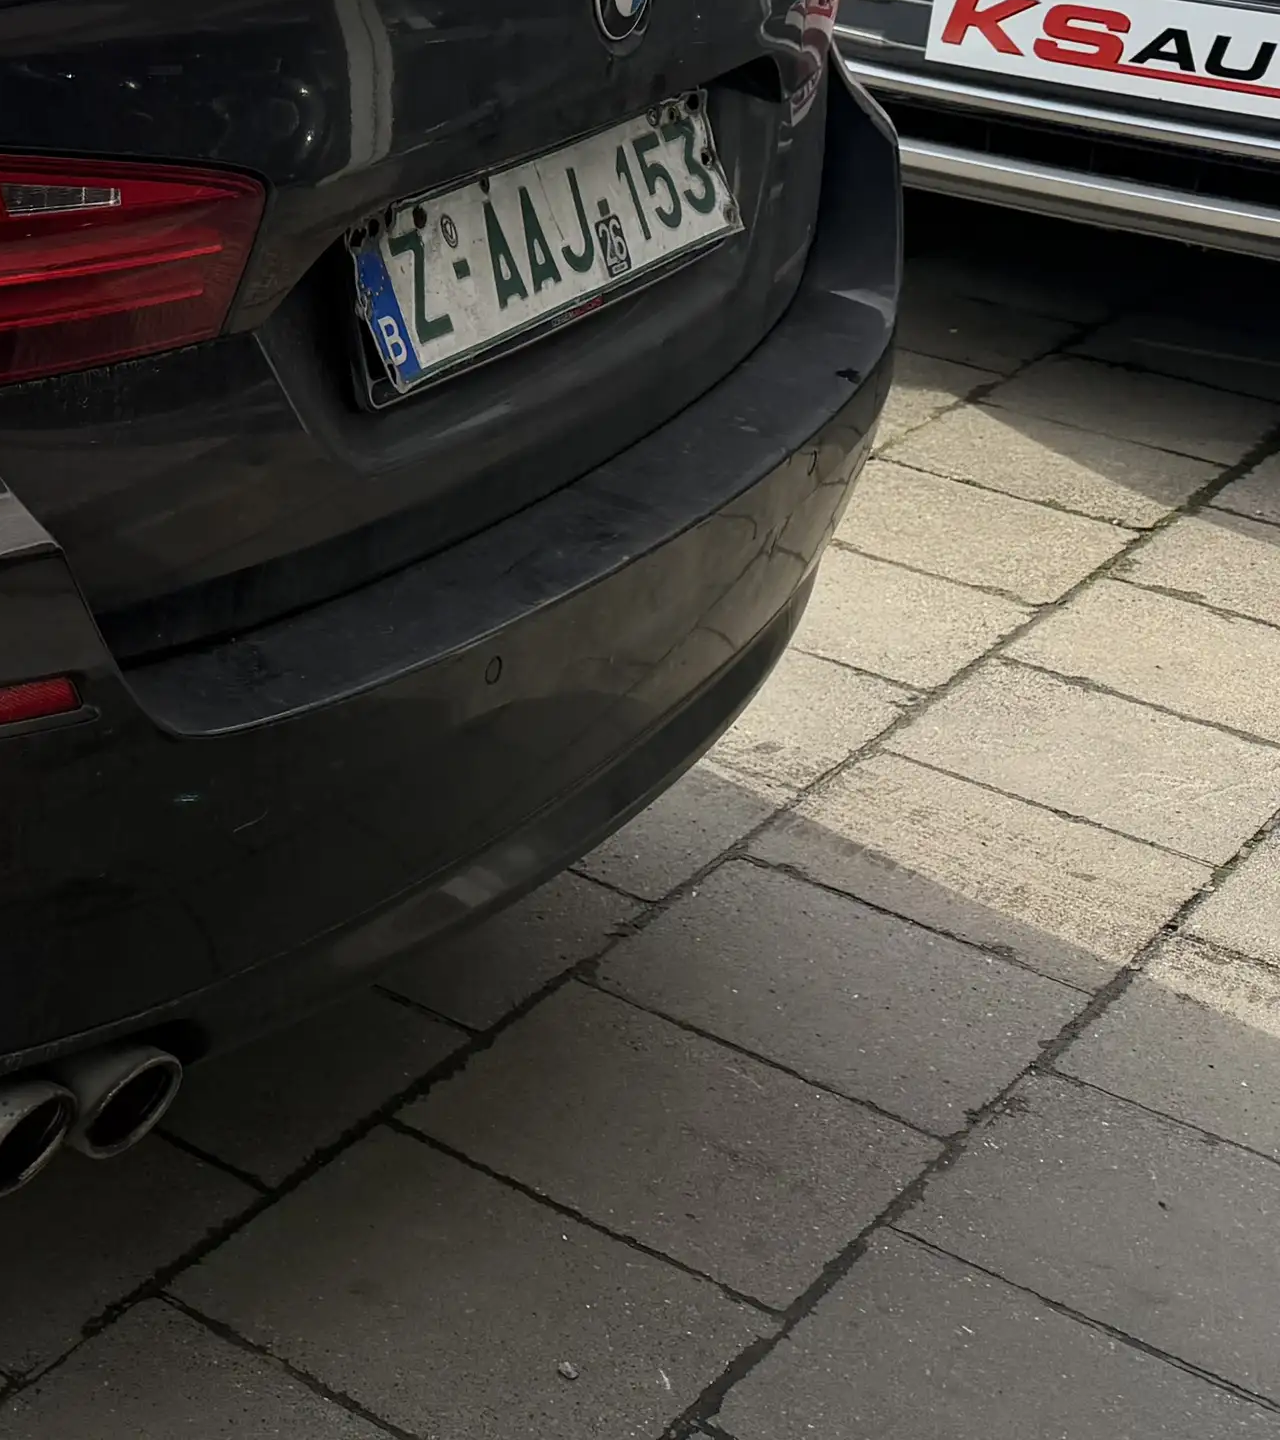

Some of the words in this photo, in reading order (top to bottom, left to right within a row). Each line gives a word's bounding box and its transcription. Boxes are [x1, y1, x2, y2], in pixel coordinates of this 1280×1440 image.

[388, 118, 717, 345] Z-AAJ-153
[598, 217, 628, 267] 26
[376, 315, 408, 366] B
